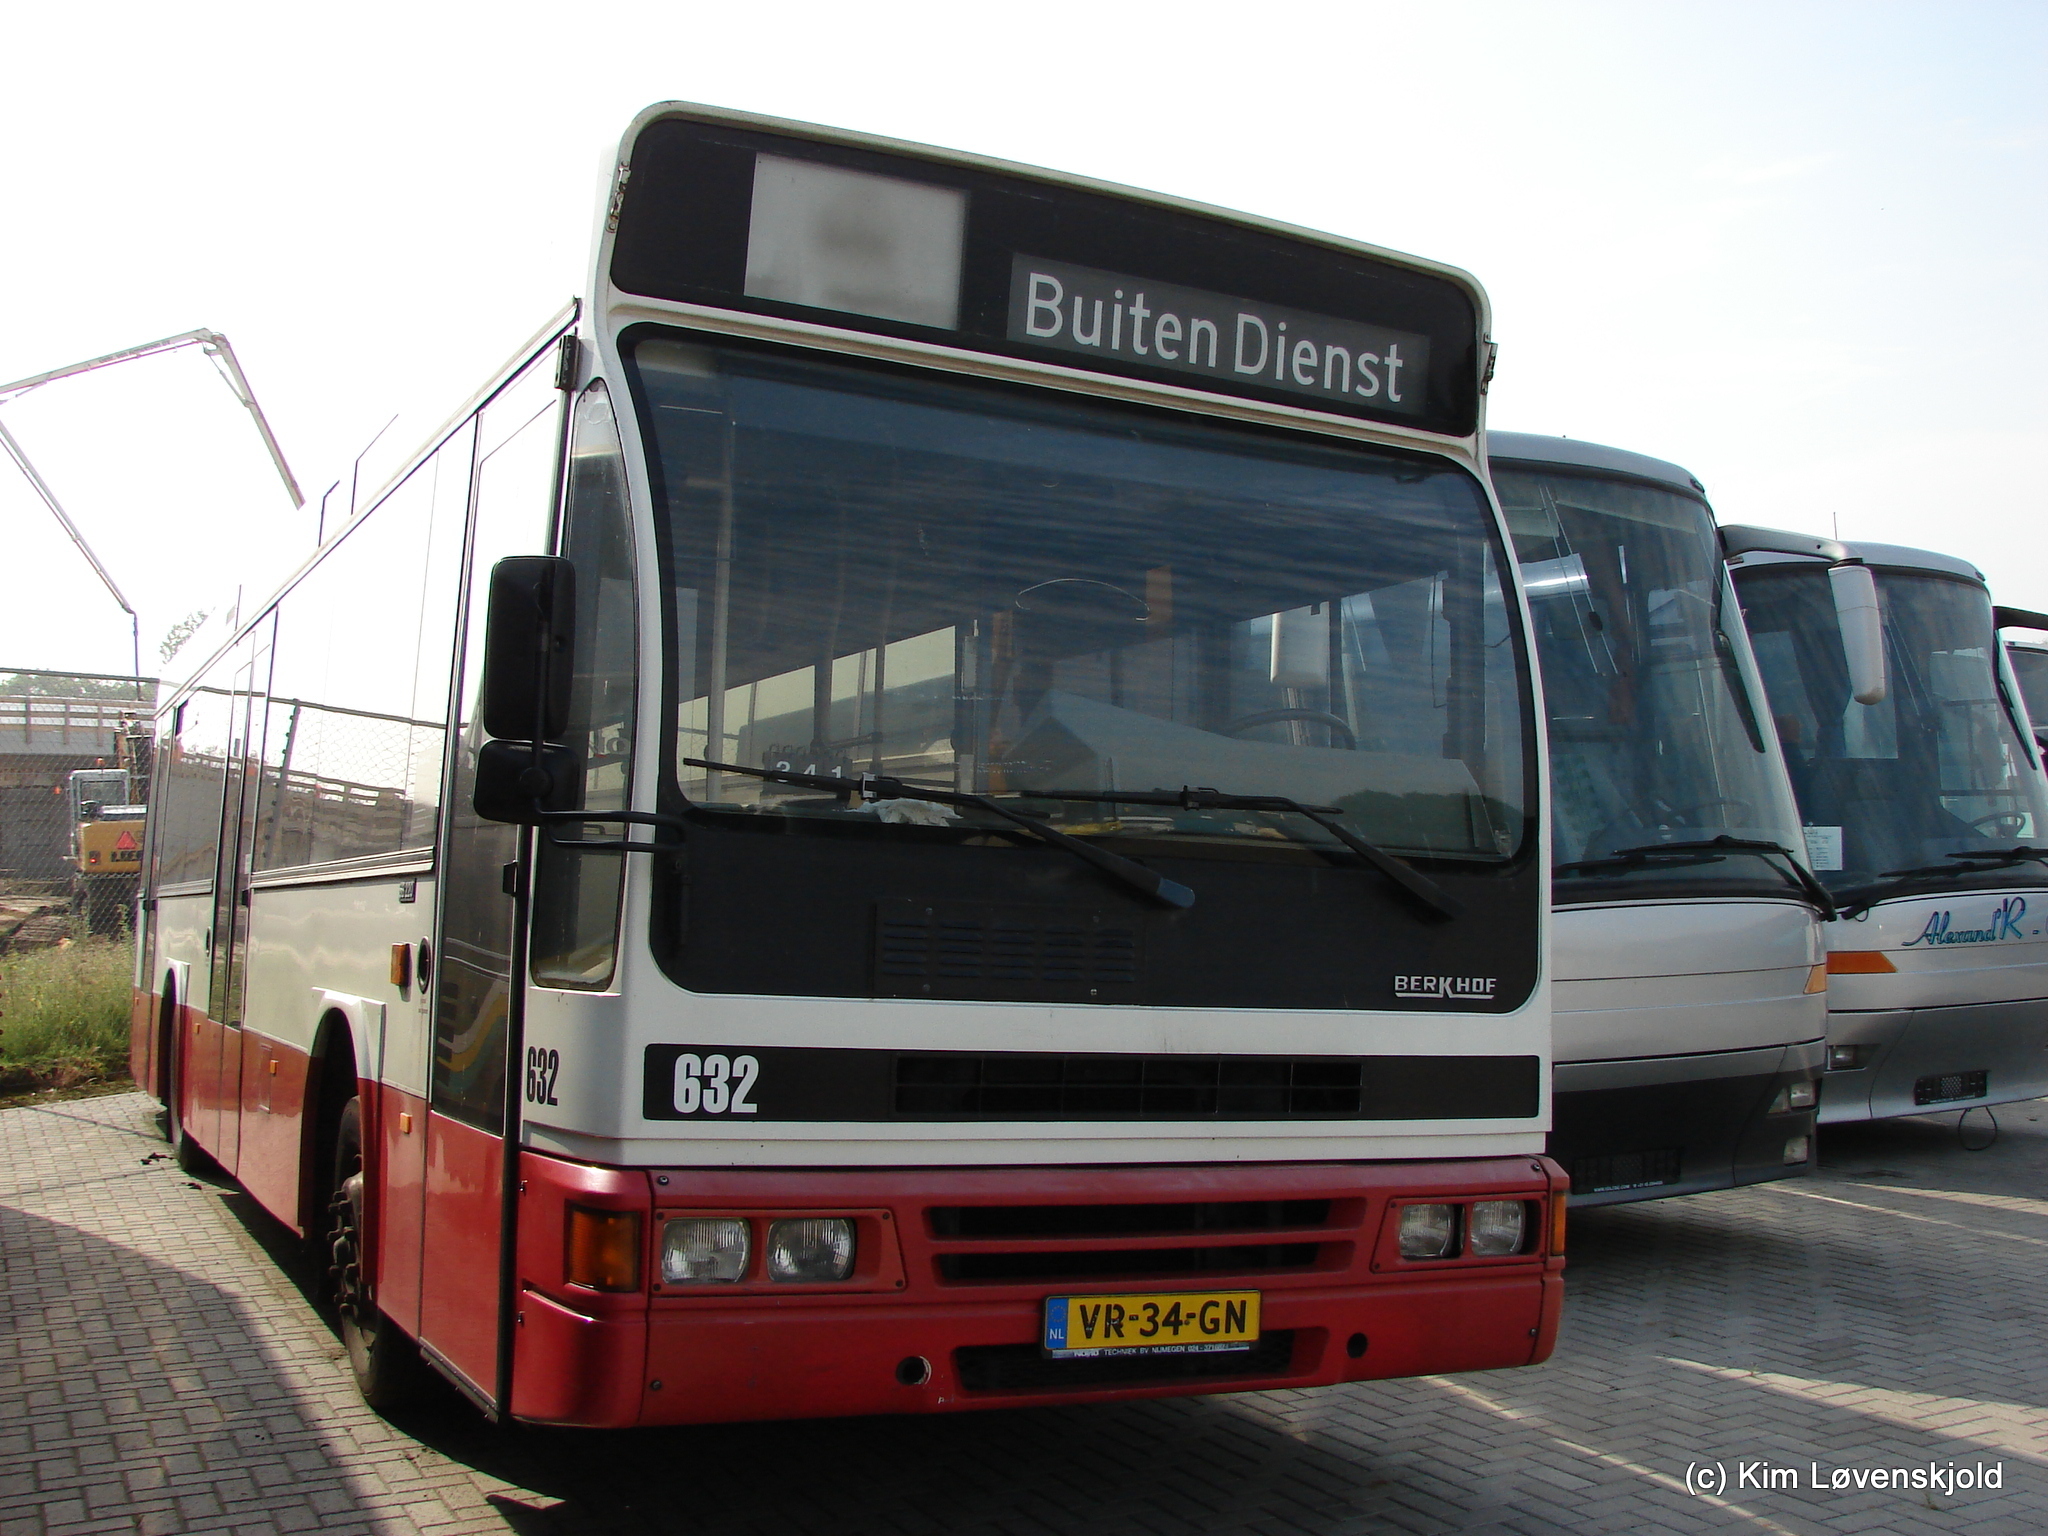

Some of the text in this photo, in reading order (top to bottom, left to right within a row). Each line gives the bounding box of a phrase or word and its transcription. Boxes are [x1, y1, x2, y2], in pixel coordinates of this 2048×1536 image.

[1025, 271, 1404, 403] Buiten Dienst
[1394, 975, 1497, 999] BERKHOF
[526, 1045, 560, 1107] 632
[673, 1052, 760, 1114] 632
[1050, 1328, 1065, 1340] NL
[1079, 1300, 1247, 1339] VR-34-GN
[1139, 1346, 1149, 1354] BV
